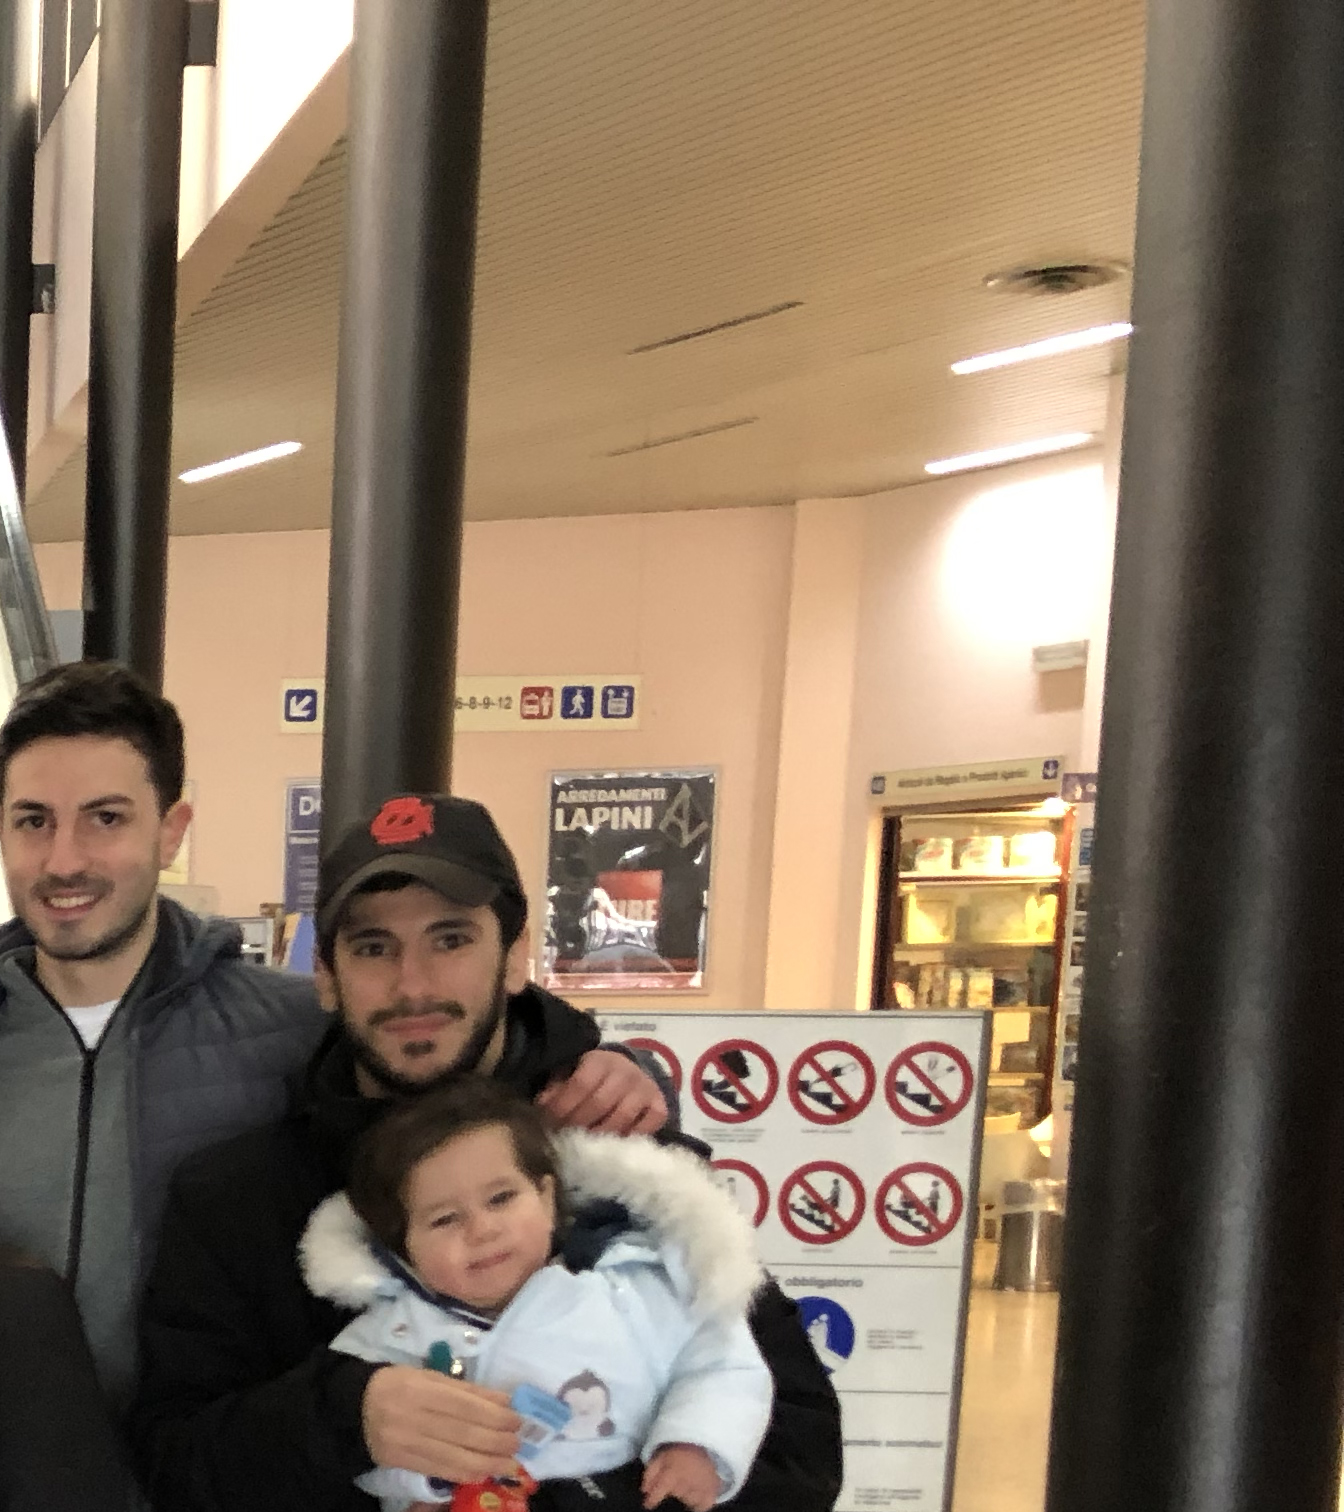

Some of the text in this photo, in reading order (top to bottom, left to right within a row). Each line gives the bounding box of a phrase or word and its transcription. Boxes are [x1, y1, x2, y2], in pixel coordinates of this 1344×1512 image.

[557, 787, 667, 803] ARREDAMENTI
[555, 806, 652, 832] LAPINI
[784, 1275, 864, 1289] obbligatorio
